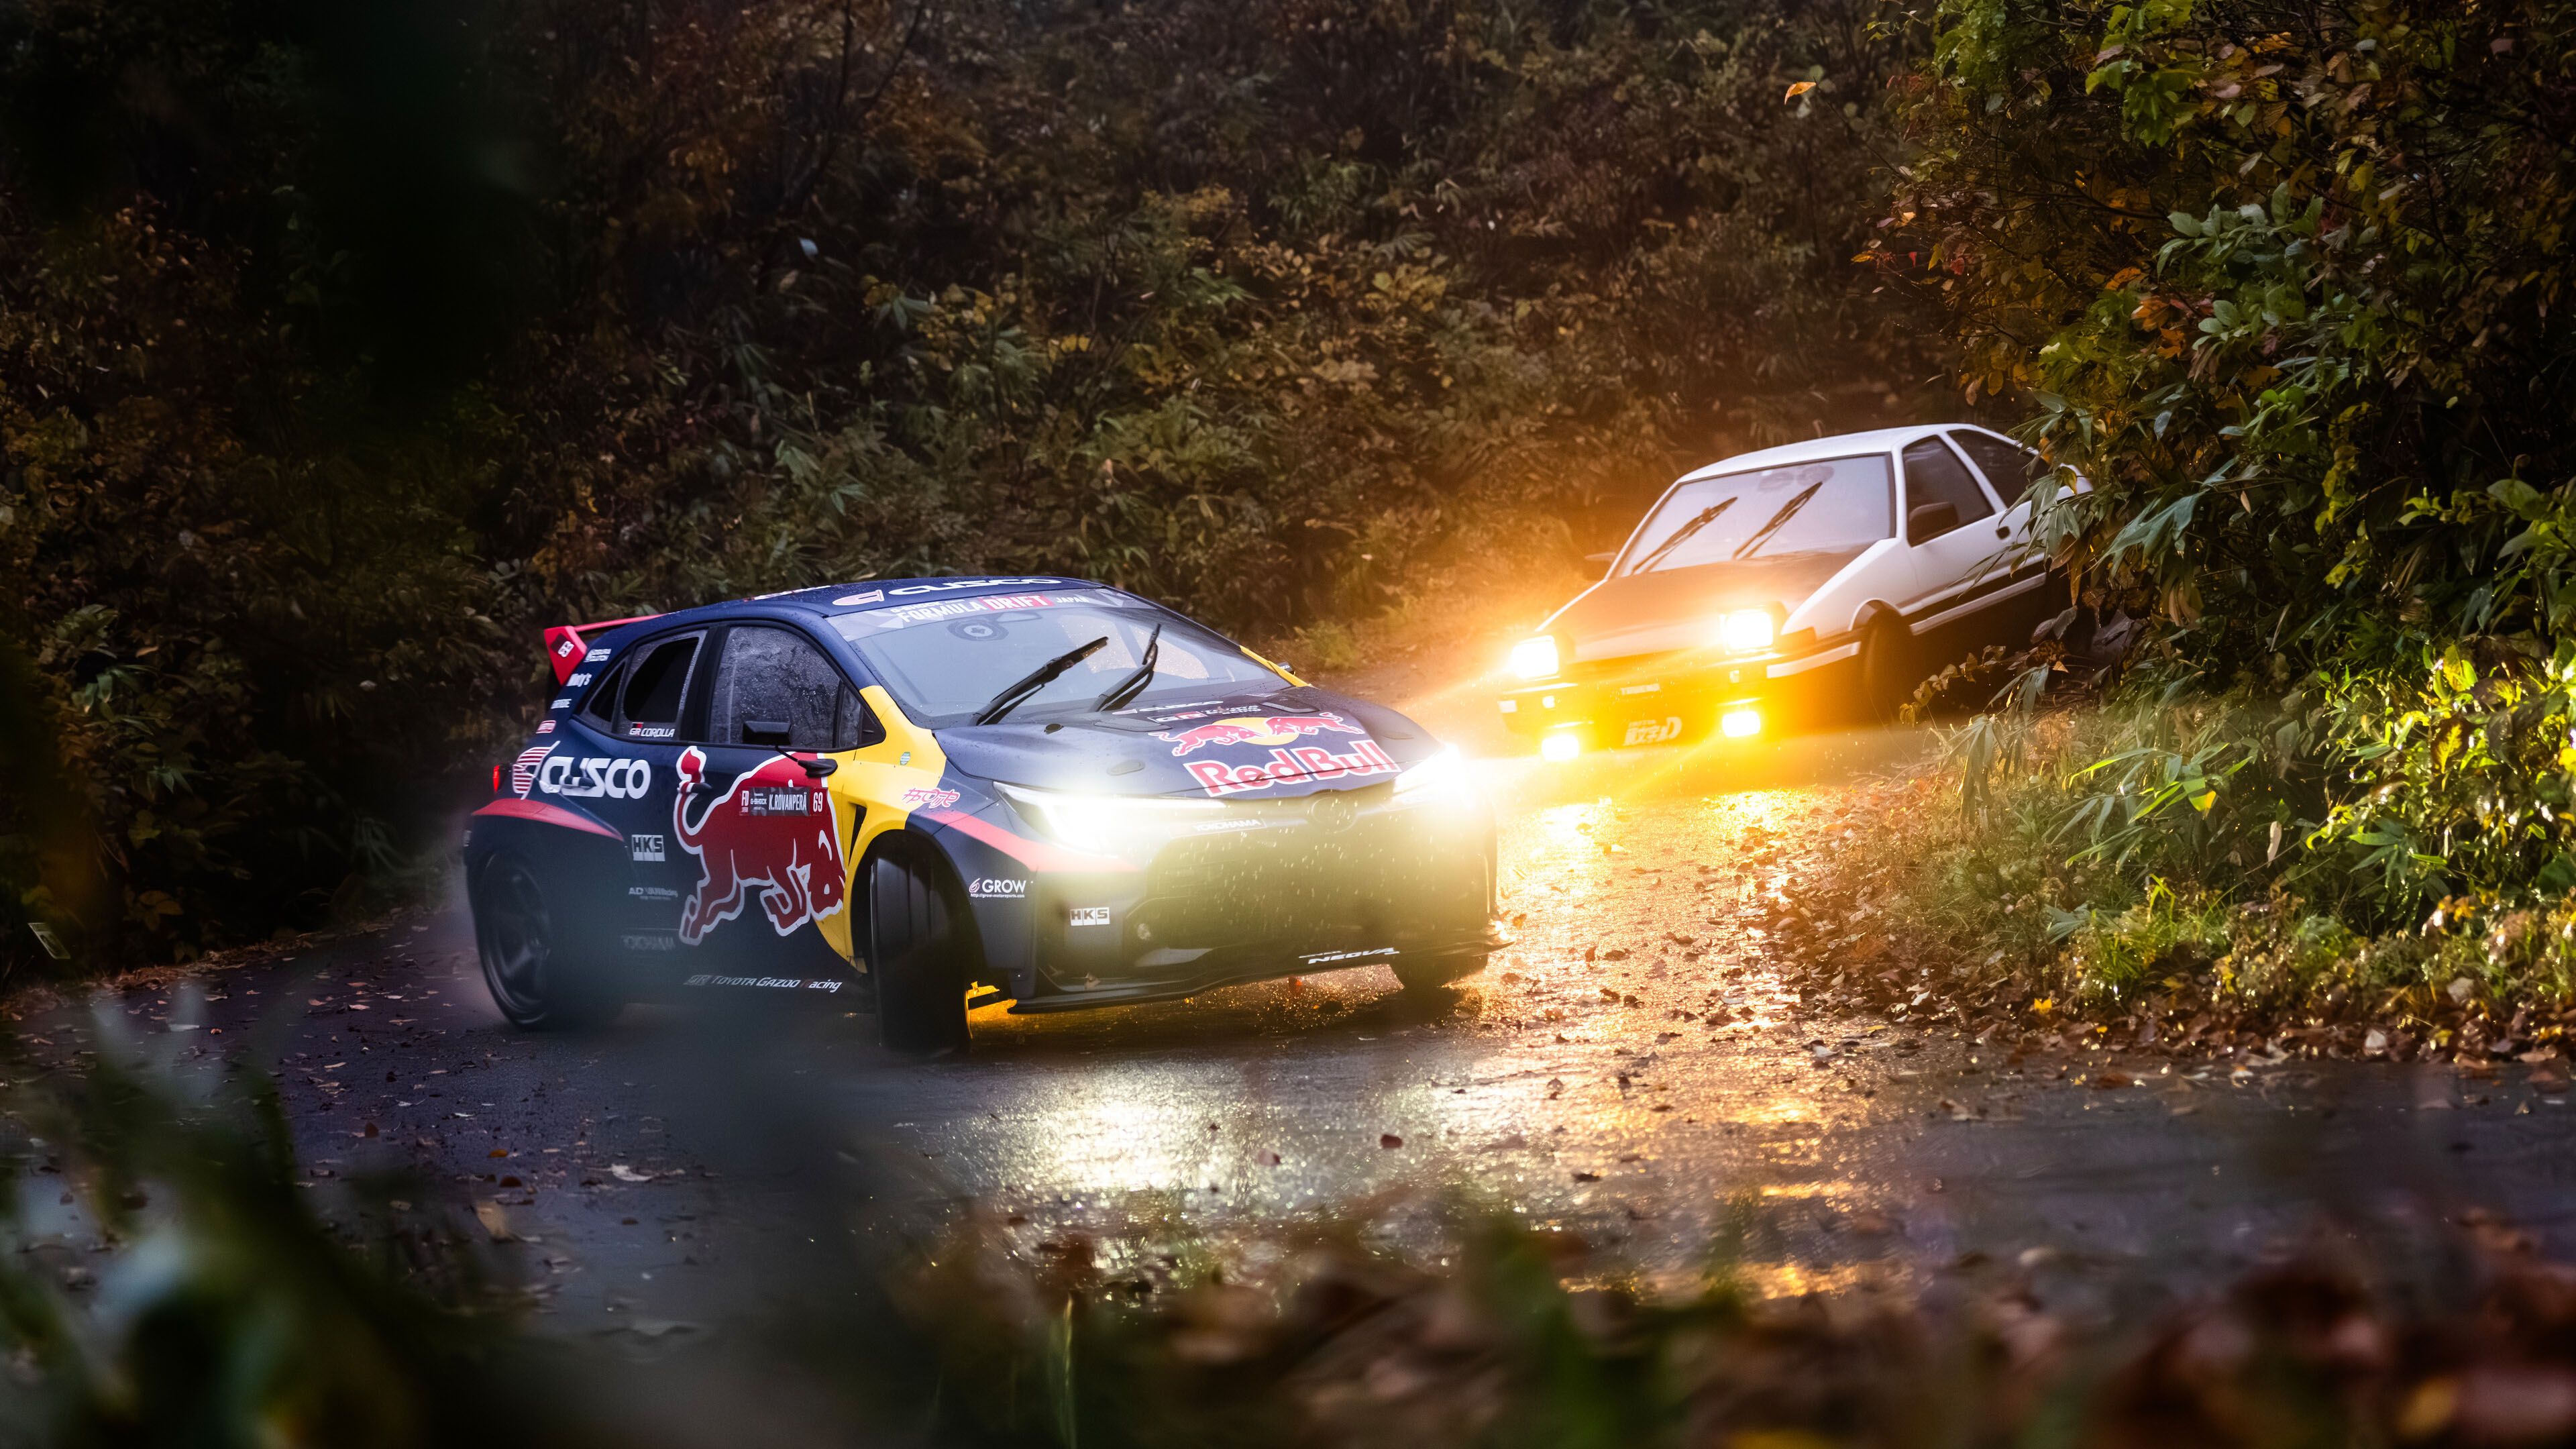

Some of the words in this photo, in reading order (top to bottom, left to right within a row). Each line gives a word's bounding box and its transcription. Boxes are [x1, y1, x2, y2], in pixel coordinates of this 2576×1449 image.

[888, 579, 1062, 596] CUSCO
[897, 602, 987, 623] FORMULA
[982, 595, 1049, 610] DRIFT
[641, 728, 676, 738] COROLLA
[1183, 748, 1313, 797] Red
[1291, 740, 1402, 781] Bull
[539, 756, 651, 800] CUSCO
[813, 792, 824, 812] 69
[633, 836, 663, 854] HKS
[982, 879, 1027, 894] GROW
[1071, 908, 1108, 922] HKS
